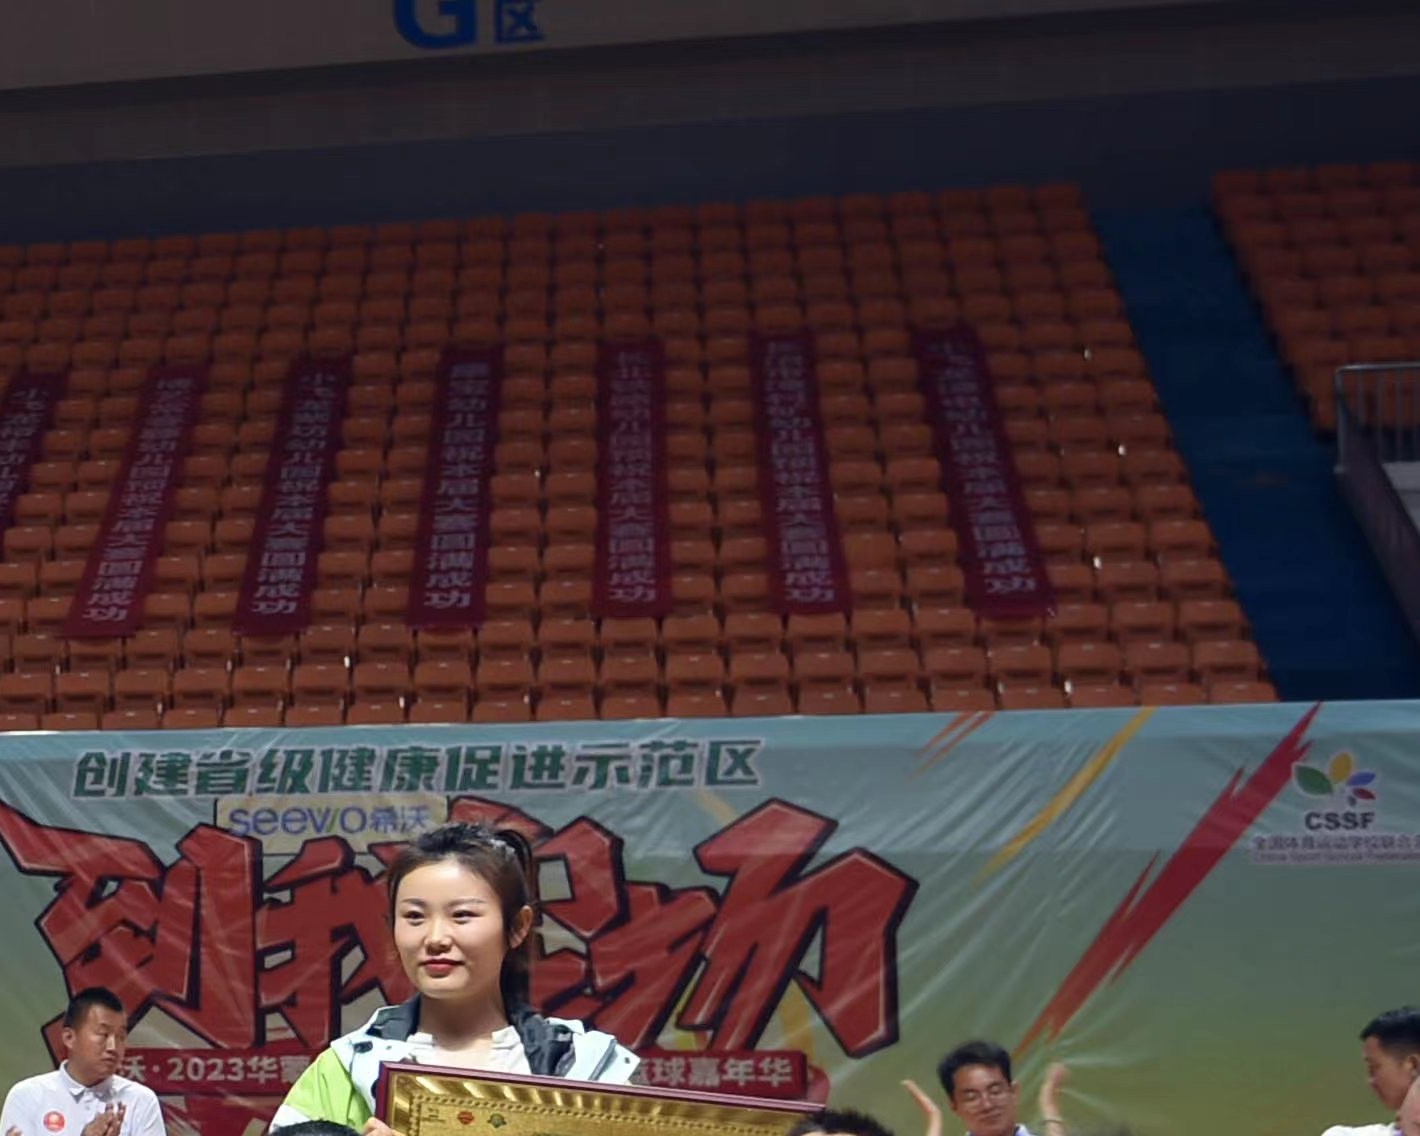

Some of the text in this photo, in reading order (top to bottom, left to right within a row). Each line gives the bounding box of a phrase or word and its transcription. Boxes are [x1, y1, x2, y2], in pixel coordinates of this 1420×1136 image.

[73, 738, 763, 798] 创建省级健康促进示范区
[1304, 811, 1375, 831] CSSF
